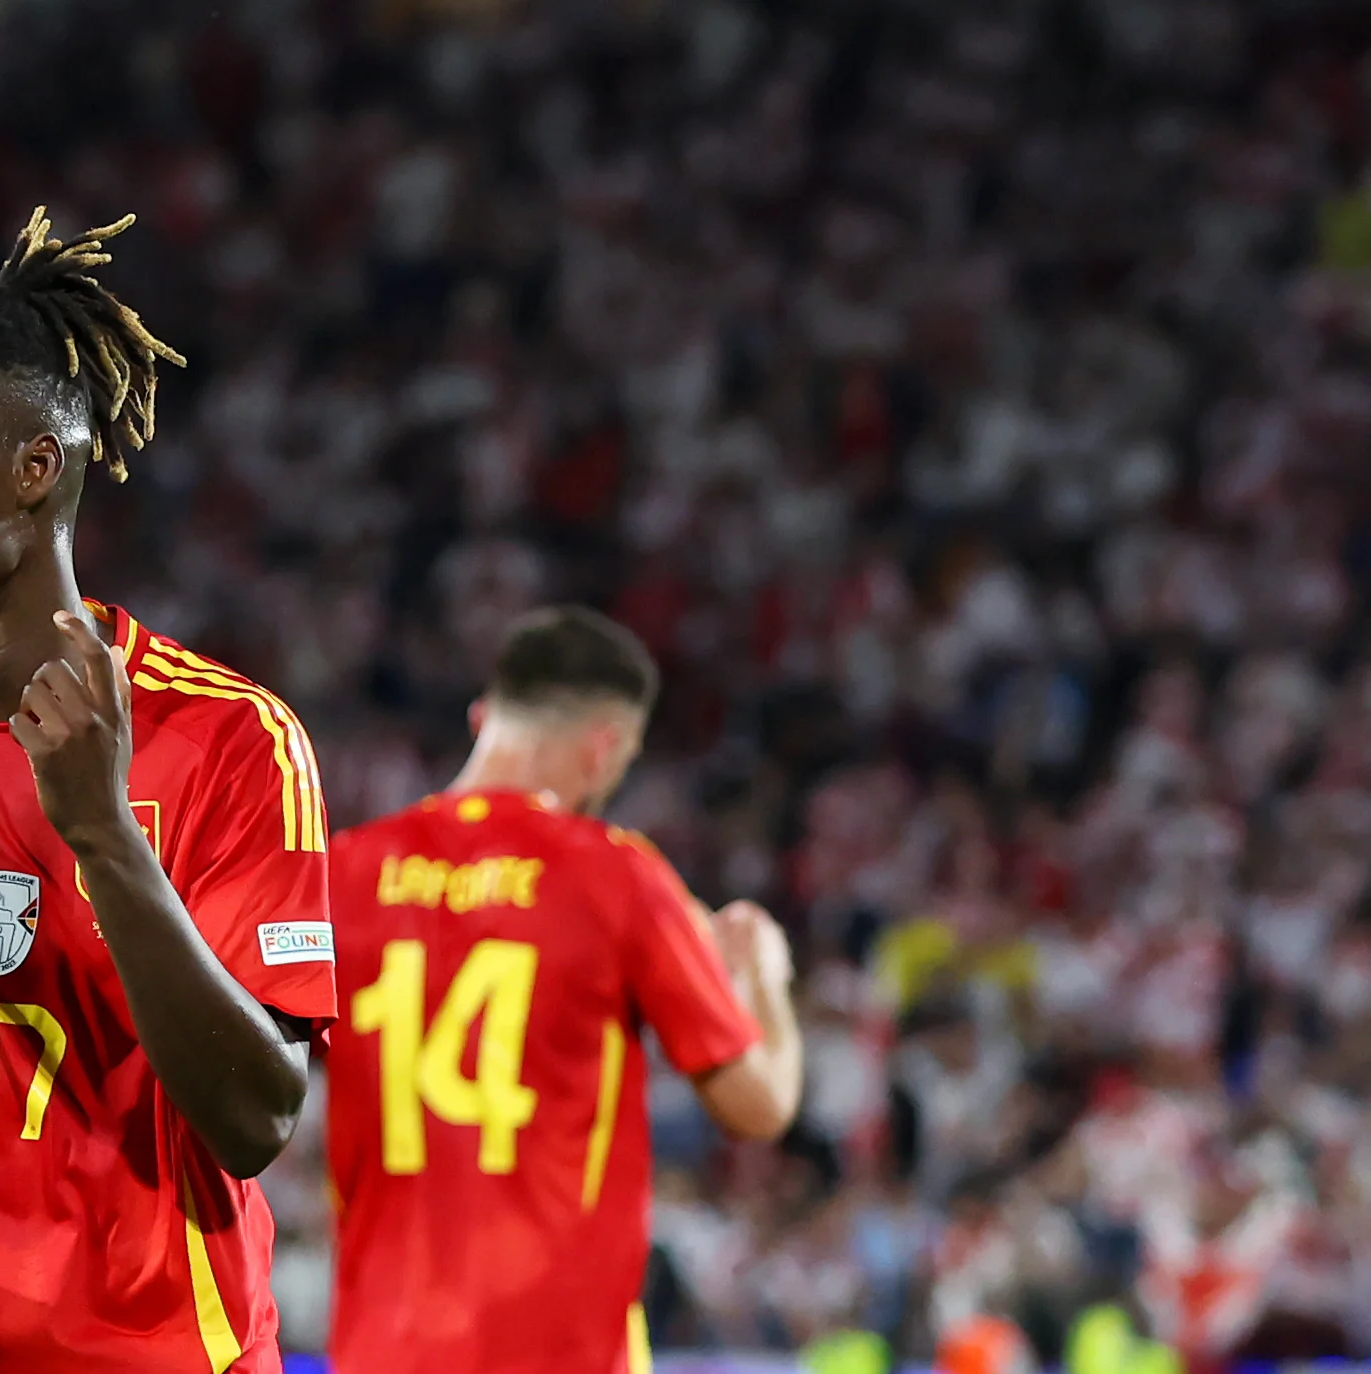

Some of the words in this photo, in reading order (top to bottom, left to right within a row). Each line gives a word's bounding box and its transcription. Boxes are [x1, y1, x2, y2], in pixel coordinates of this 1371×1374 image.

[8, 874, 35, 885] LEAGUE
[263, 925, 291, 936] UEFA
[1, 959, 17, 972] 2023
[352, 937, 538, 1176] 14
